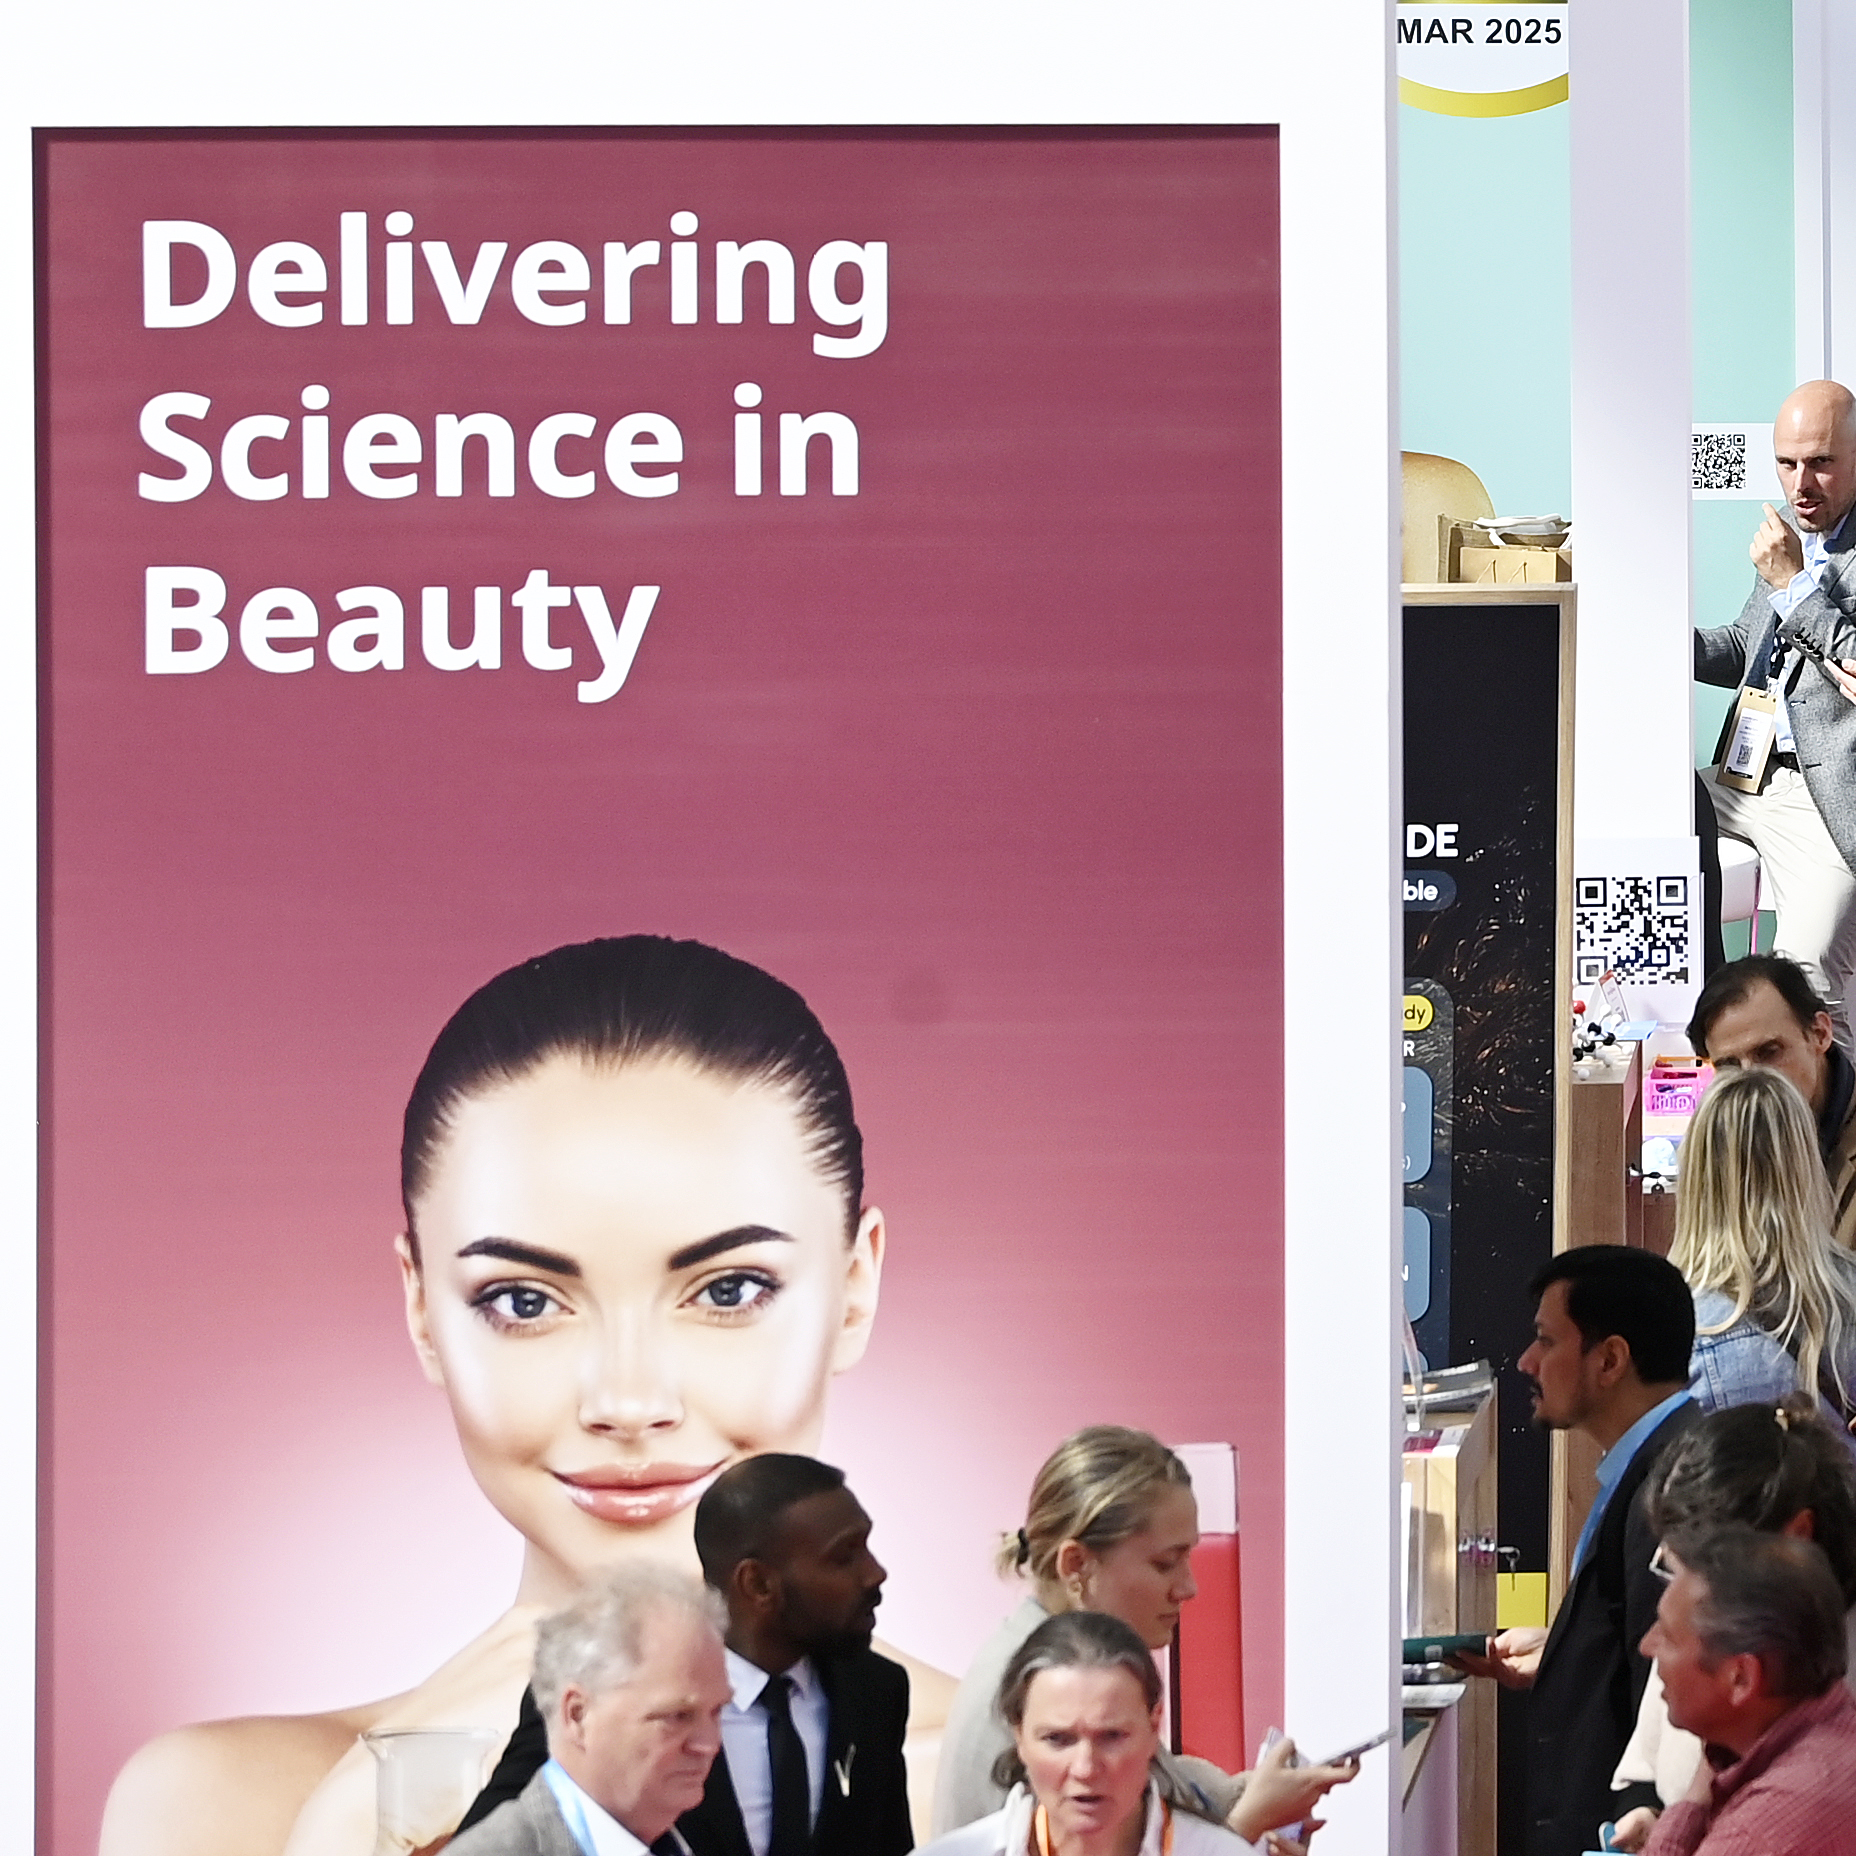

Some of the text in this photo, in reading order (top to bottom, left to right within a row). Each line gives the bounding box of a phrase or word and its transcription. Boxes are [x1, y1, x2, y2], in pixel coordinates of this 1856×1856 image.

[1397, 18, 1561, 45] MAR 2025
[143, 211, 887, 358] Delivering
[139, 383, 858, 502] Science in
[146, 567, 660, 703] Beauty
